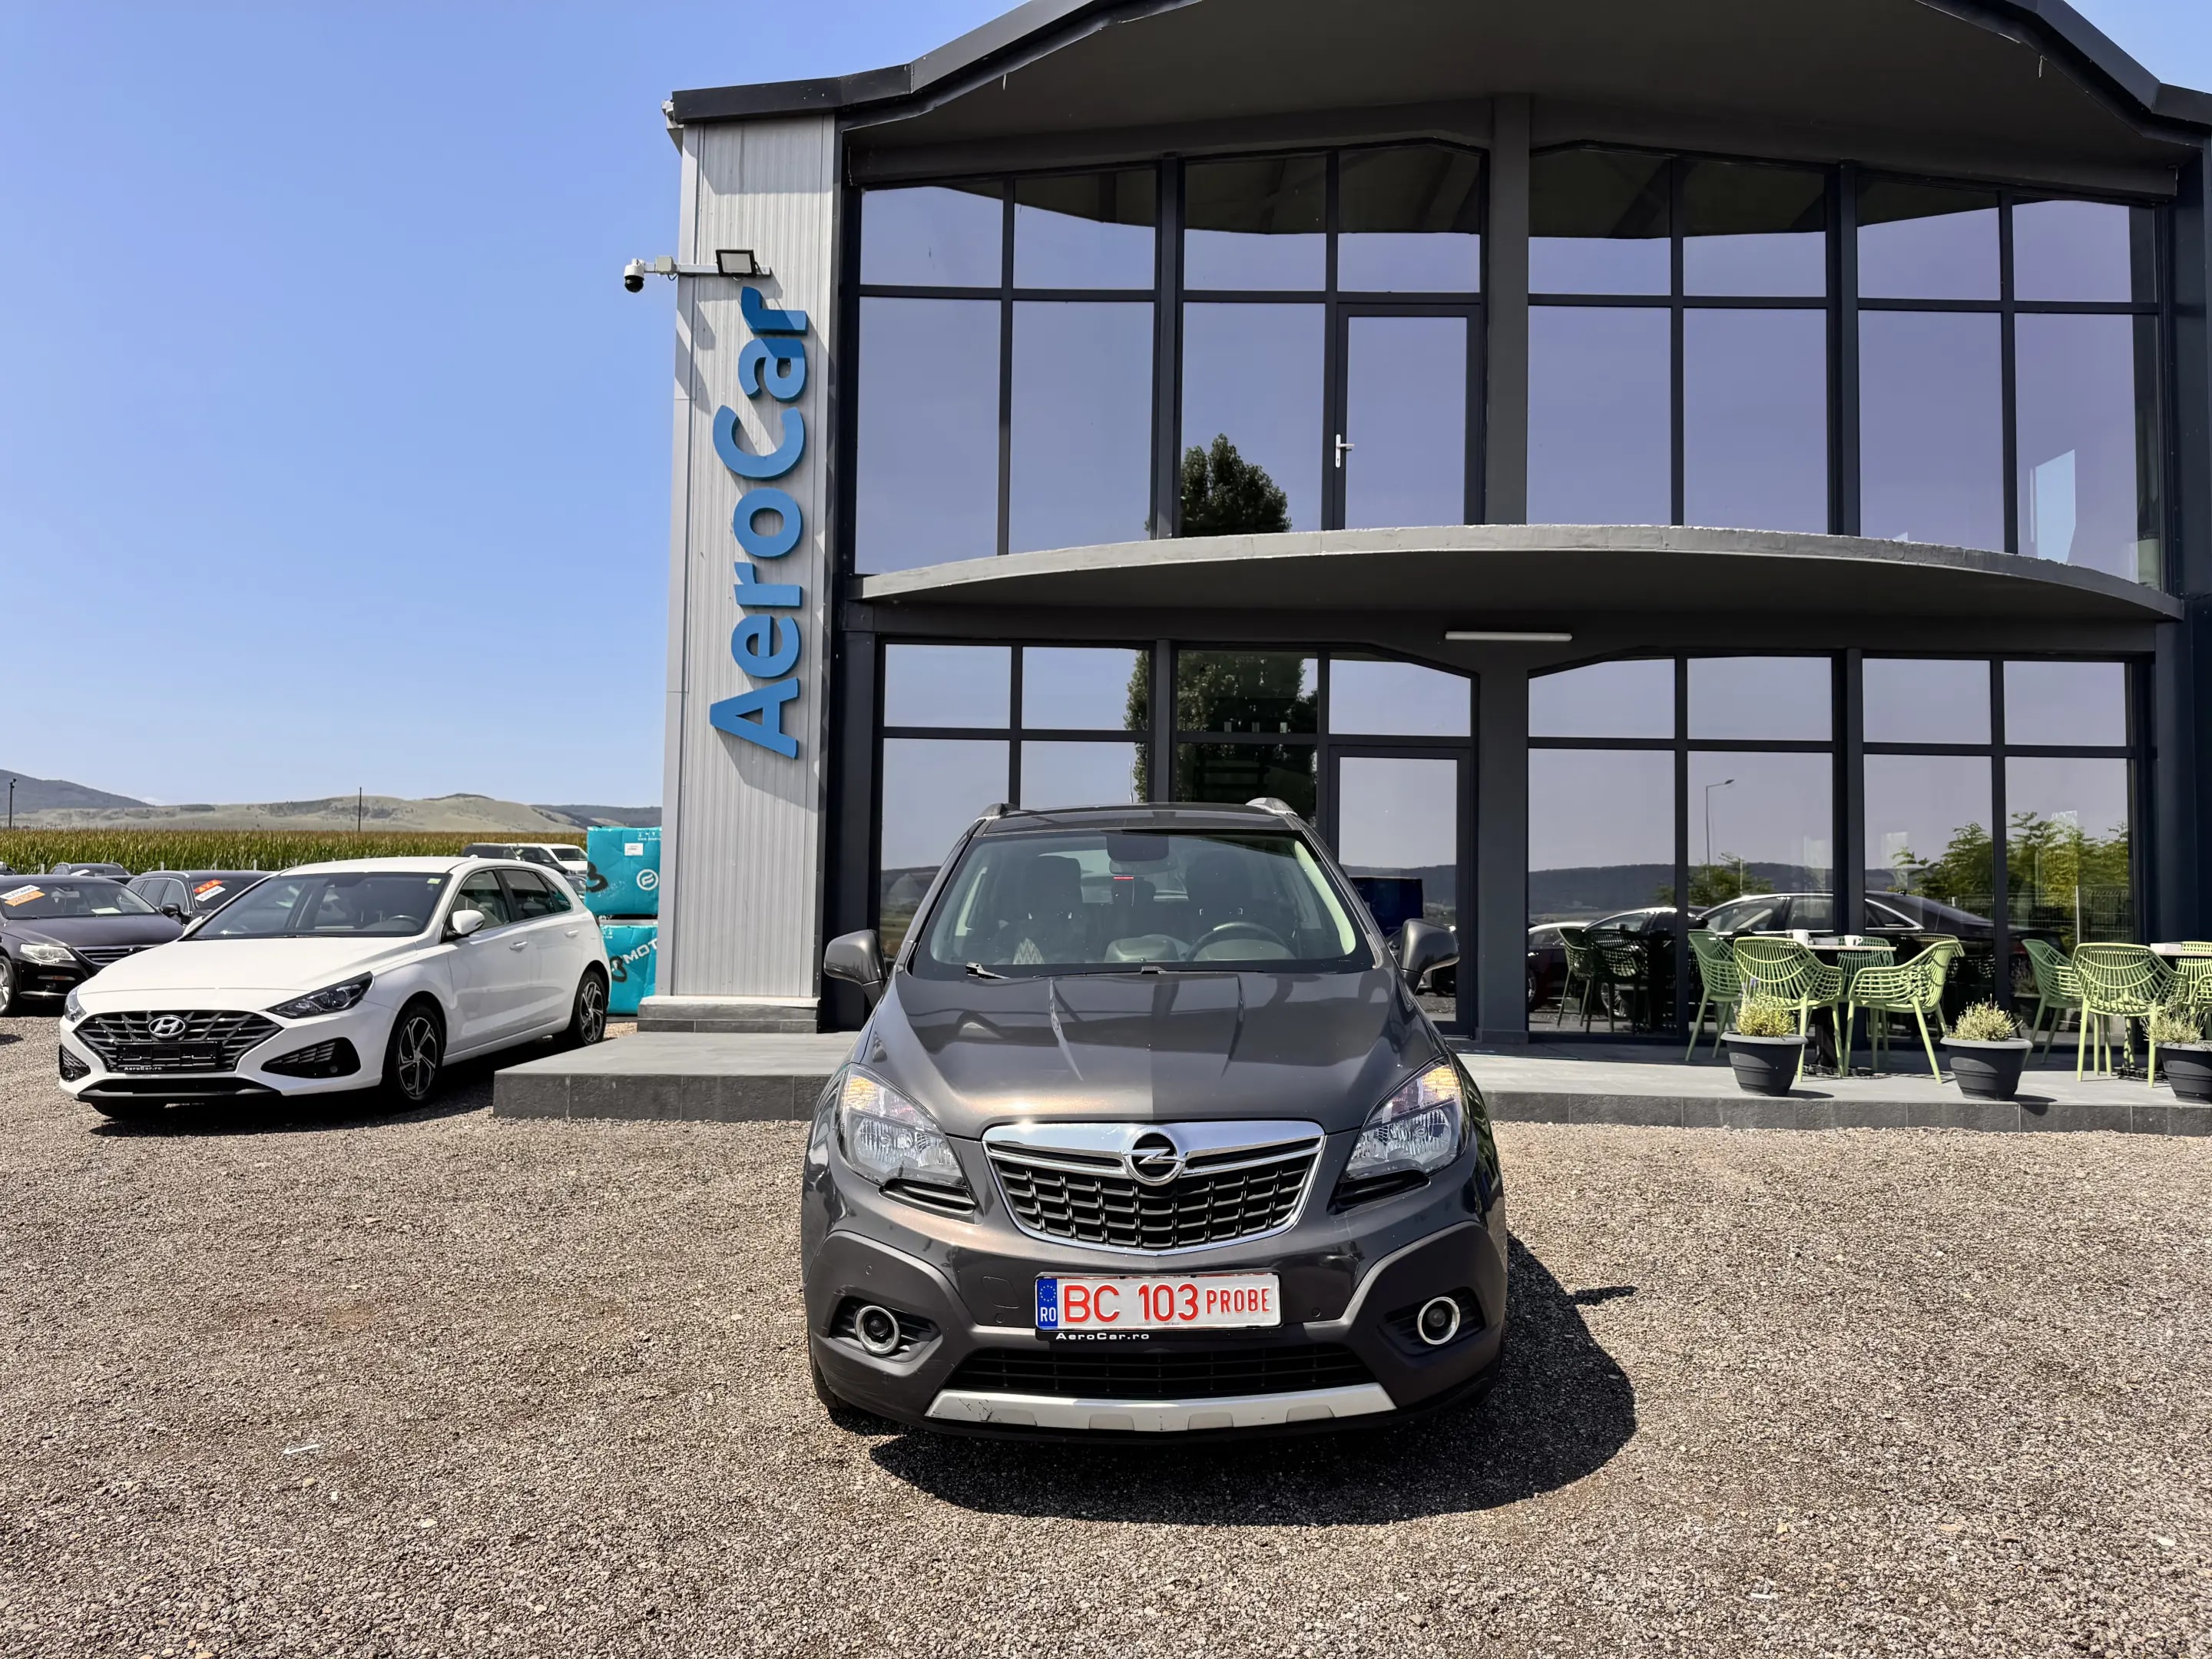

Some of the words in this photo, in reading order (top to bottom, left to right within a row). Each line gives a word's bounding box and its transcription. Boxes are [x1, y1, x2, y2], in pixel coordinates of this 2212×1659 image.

[710, 286, 809, 760] AeroCar
[1040, 1306, 1057, 1322] RO
[1063, 1284, 1120, 1323] BC
[1137, 1283, 1199, 1321] 103
[1206, 1286, 1272, 1314] PROBE
